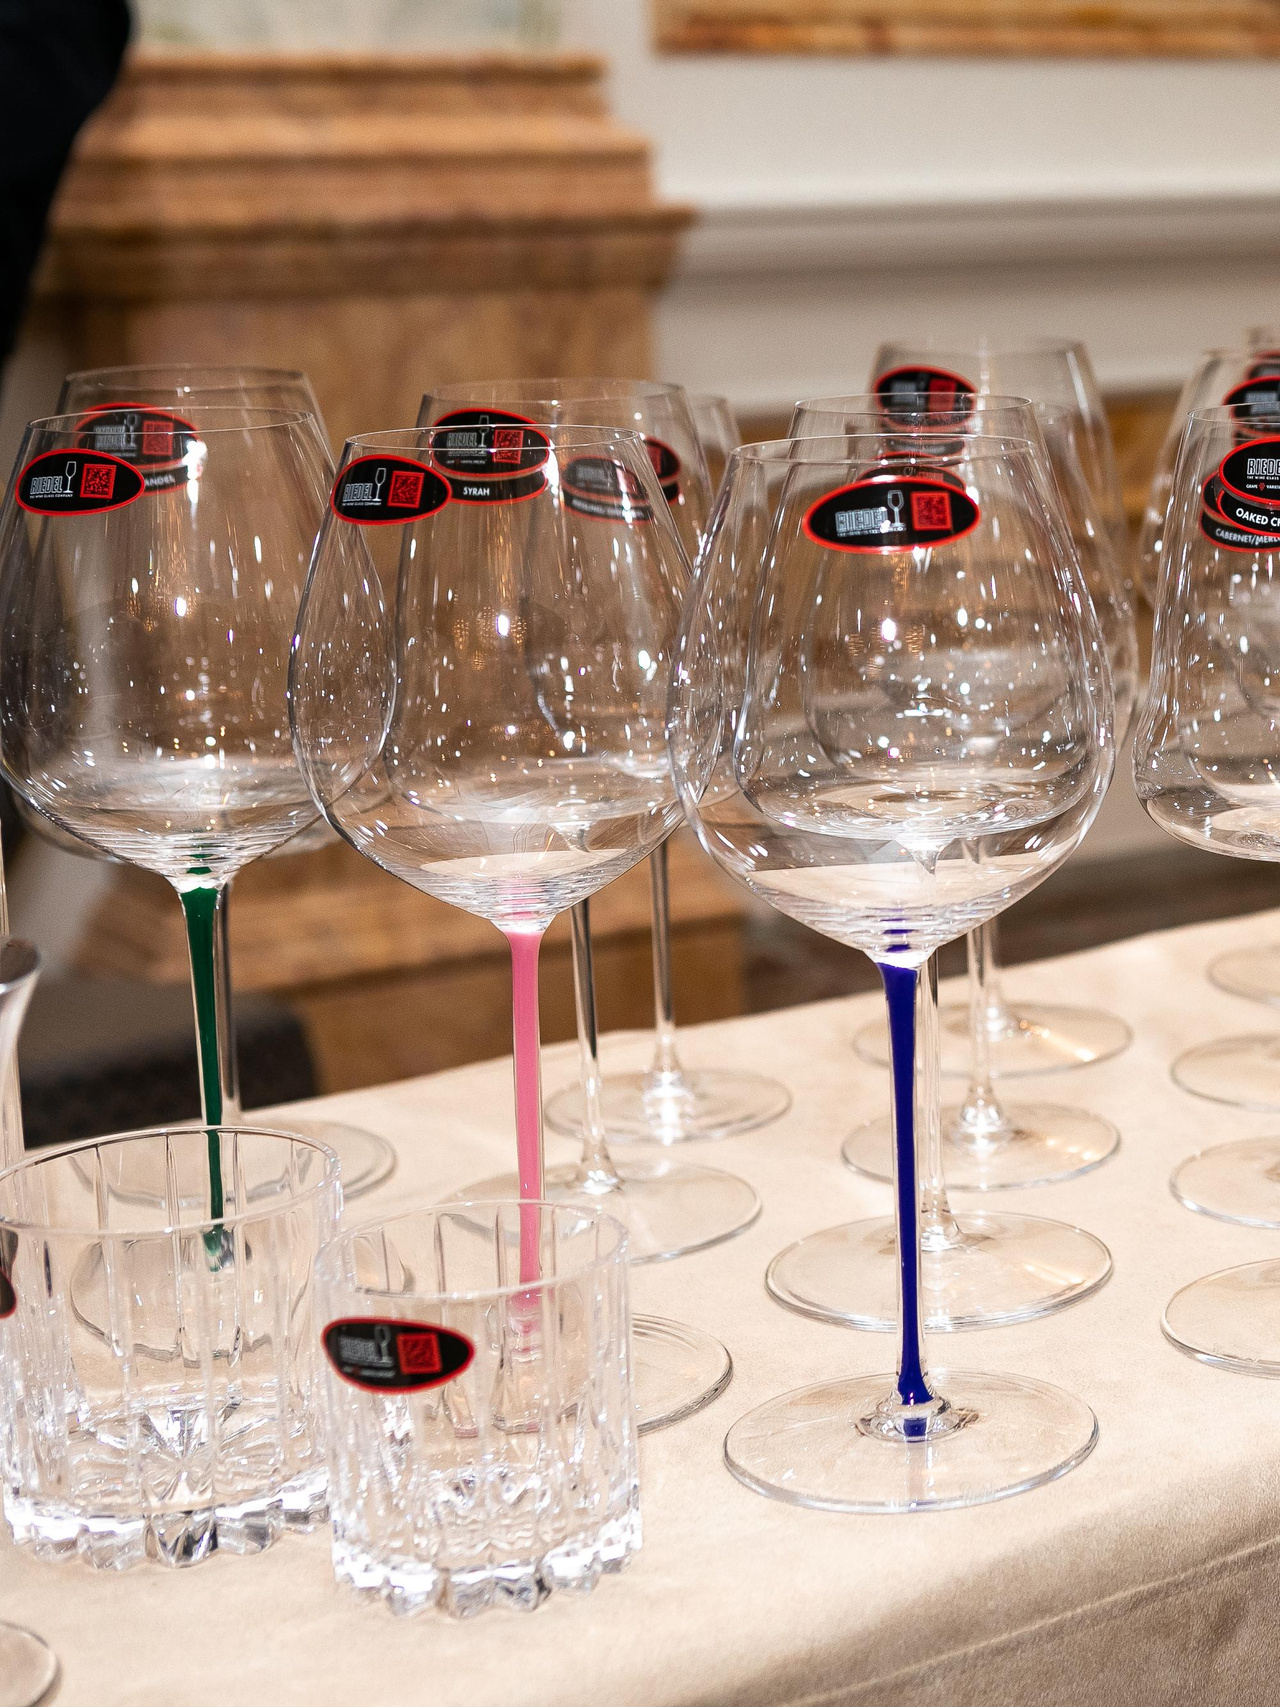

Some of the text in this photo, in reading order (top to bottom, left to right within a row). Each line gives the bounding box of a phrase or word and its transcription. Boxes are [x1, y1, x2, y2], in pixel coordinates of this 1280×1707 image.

[30, 475, 63, 494] RIEDEL
[342, 483, 373, 501] RIEDEL
[463, 486, 490, 496] SYRAH
[1235, 508, 1268, 524] OAKED
